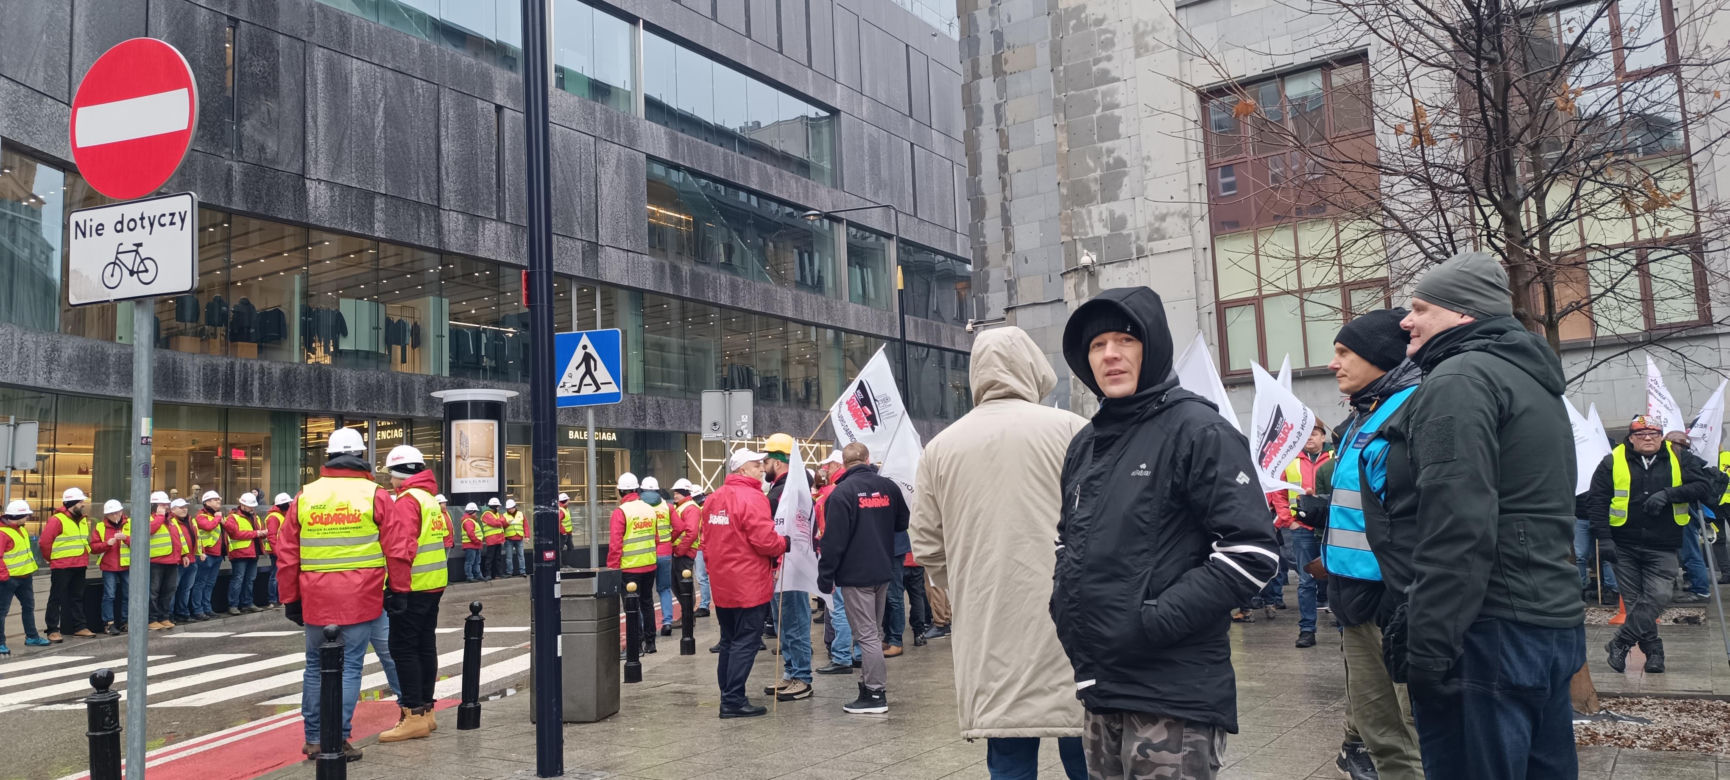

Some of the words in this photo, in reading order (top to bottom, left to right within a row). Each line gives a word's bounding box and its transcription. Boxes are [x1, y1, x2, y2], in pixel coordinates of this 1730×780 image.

[74, 218, 105, 240] Nie
[114, 210, 188, 236] dotyczy
[568, 430, 617, 441] BALECIAGA
